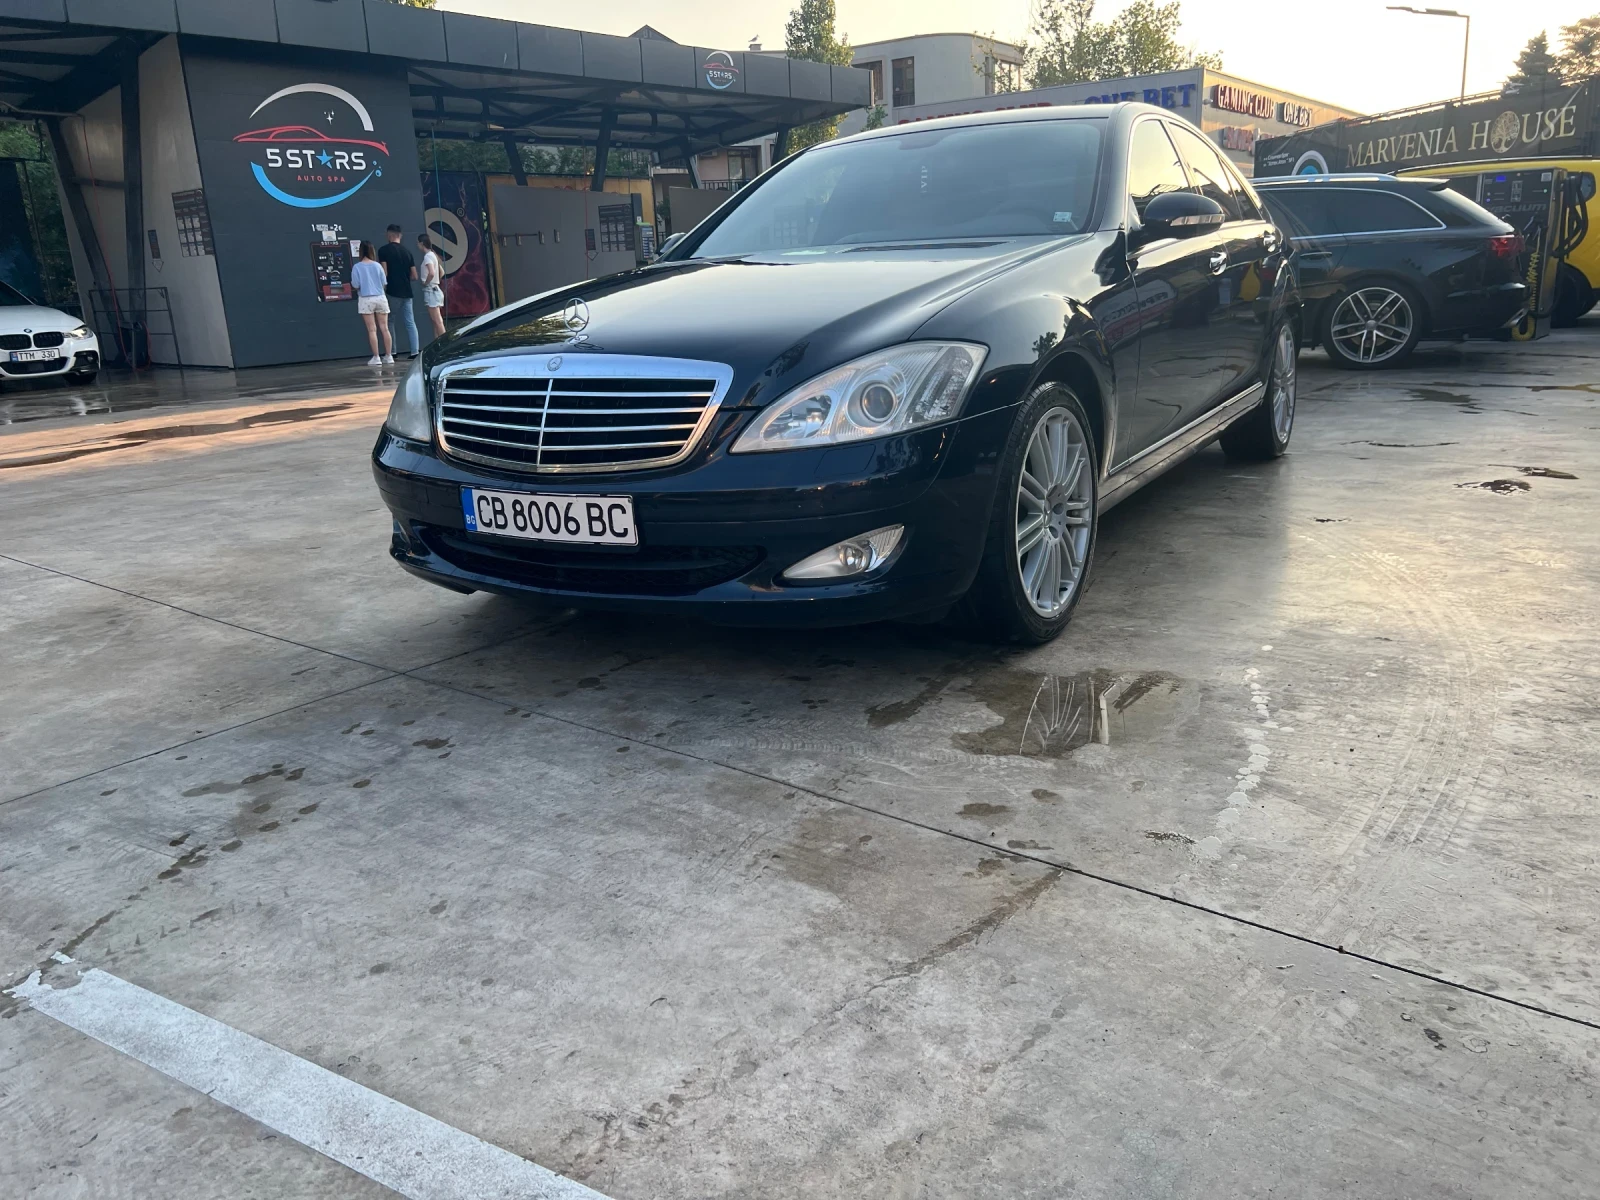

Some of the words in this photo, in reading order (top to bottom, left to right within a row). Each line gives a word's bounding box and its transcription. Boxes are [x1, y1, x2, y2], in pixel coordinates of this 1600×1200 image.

[1143, 84, 1196, 109] BET
[1218, 84, 1254, 115] GAMING
[1254, 94, 1276, 119] CLUB
[1283, 102, 1300, 125] ONE
[1346, 125, 1459, 169] MARVENIA
[1468, 105, 1577, 152] HUSE
[286, 149, 367, 171] STRS
[466, 514, 475, 525] BG
[477, 495, 508, 530] CB
[511, 499, 581, 536] 8006
[585, 502, 629, 538] BC
